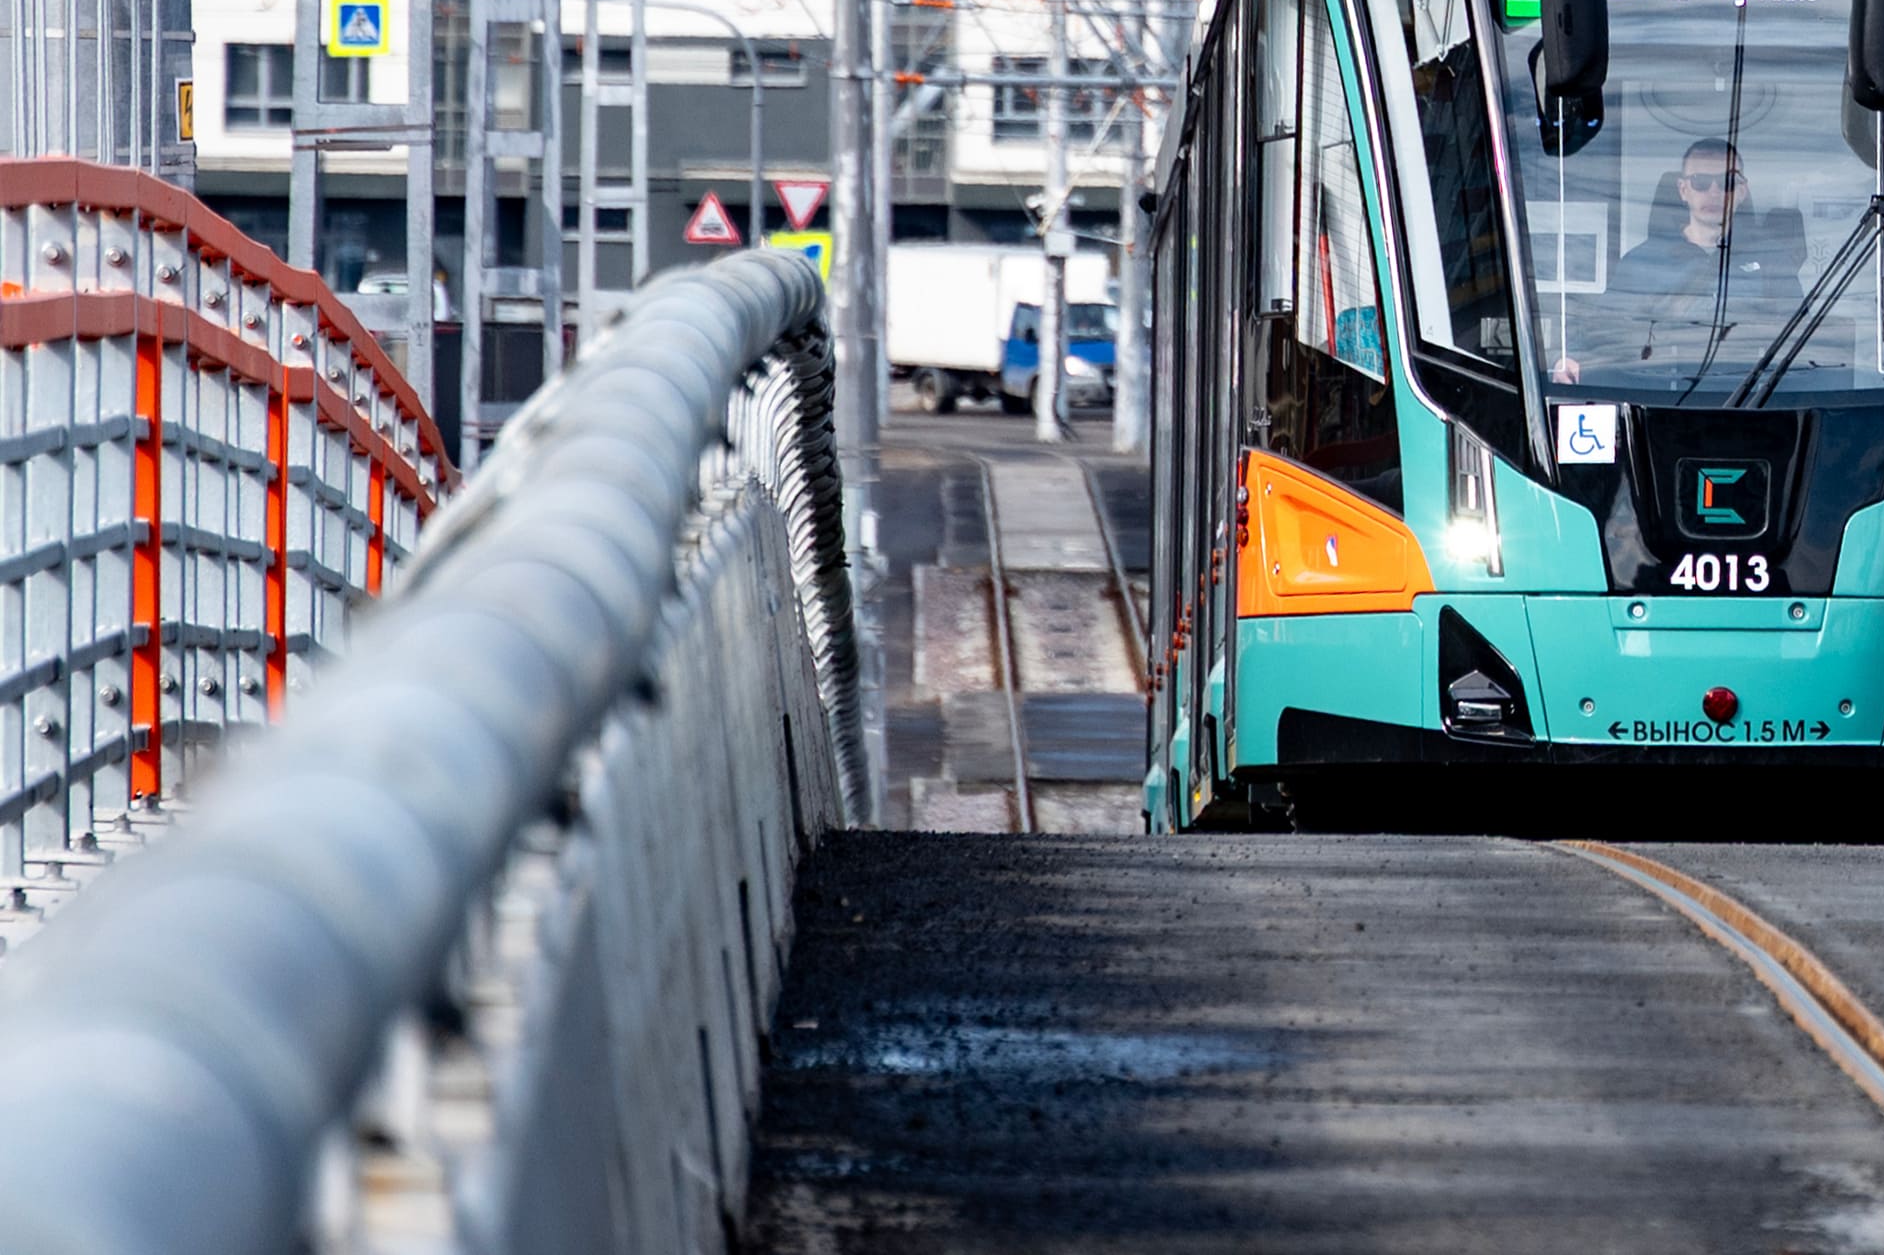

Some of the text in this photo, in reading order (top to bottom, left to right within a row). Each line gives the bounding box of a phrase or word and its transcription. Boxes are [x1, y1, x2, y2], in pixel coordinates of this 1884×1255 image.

[1671, 555, 1769, 591] 4013
[1633, 720, 1805, 742] ВЫНОС 1.5 М
